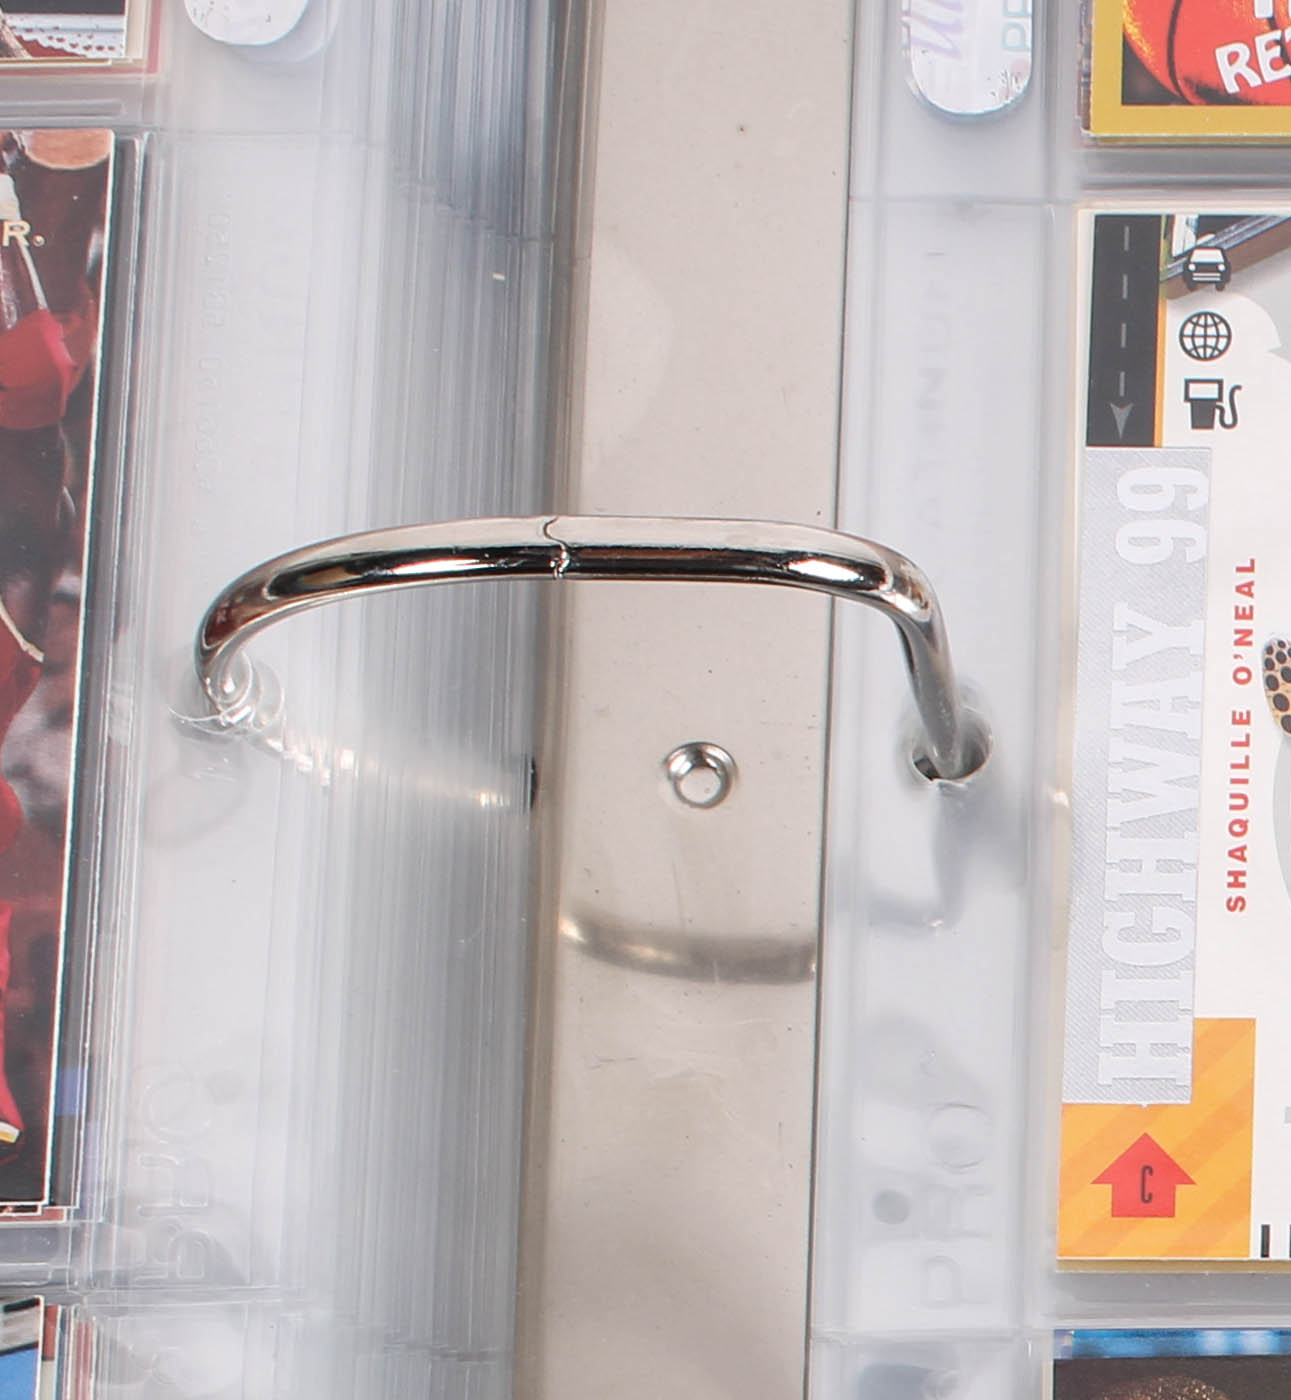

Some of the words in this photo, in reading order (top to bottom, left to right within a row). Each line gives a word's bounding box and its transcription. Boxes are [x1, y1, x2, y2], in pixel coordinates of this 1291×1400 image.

[1113, 466, 1210, 566] 99
[1231, 557, 1256, 686] O'NEAL
[1098, 602, 1206, 1090] HIGHWAY
[1226, 707, 1252, 913] SHAQUILLE
[1140, 1164, 1153, 1205] C
